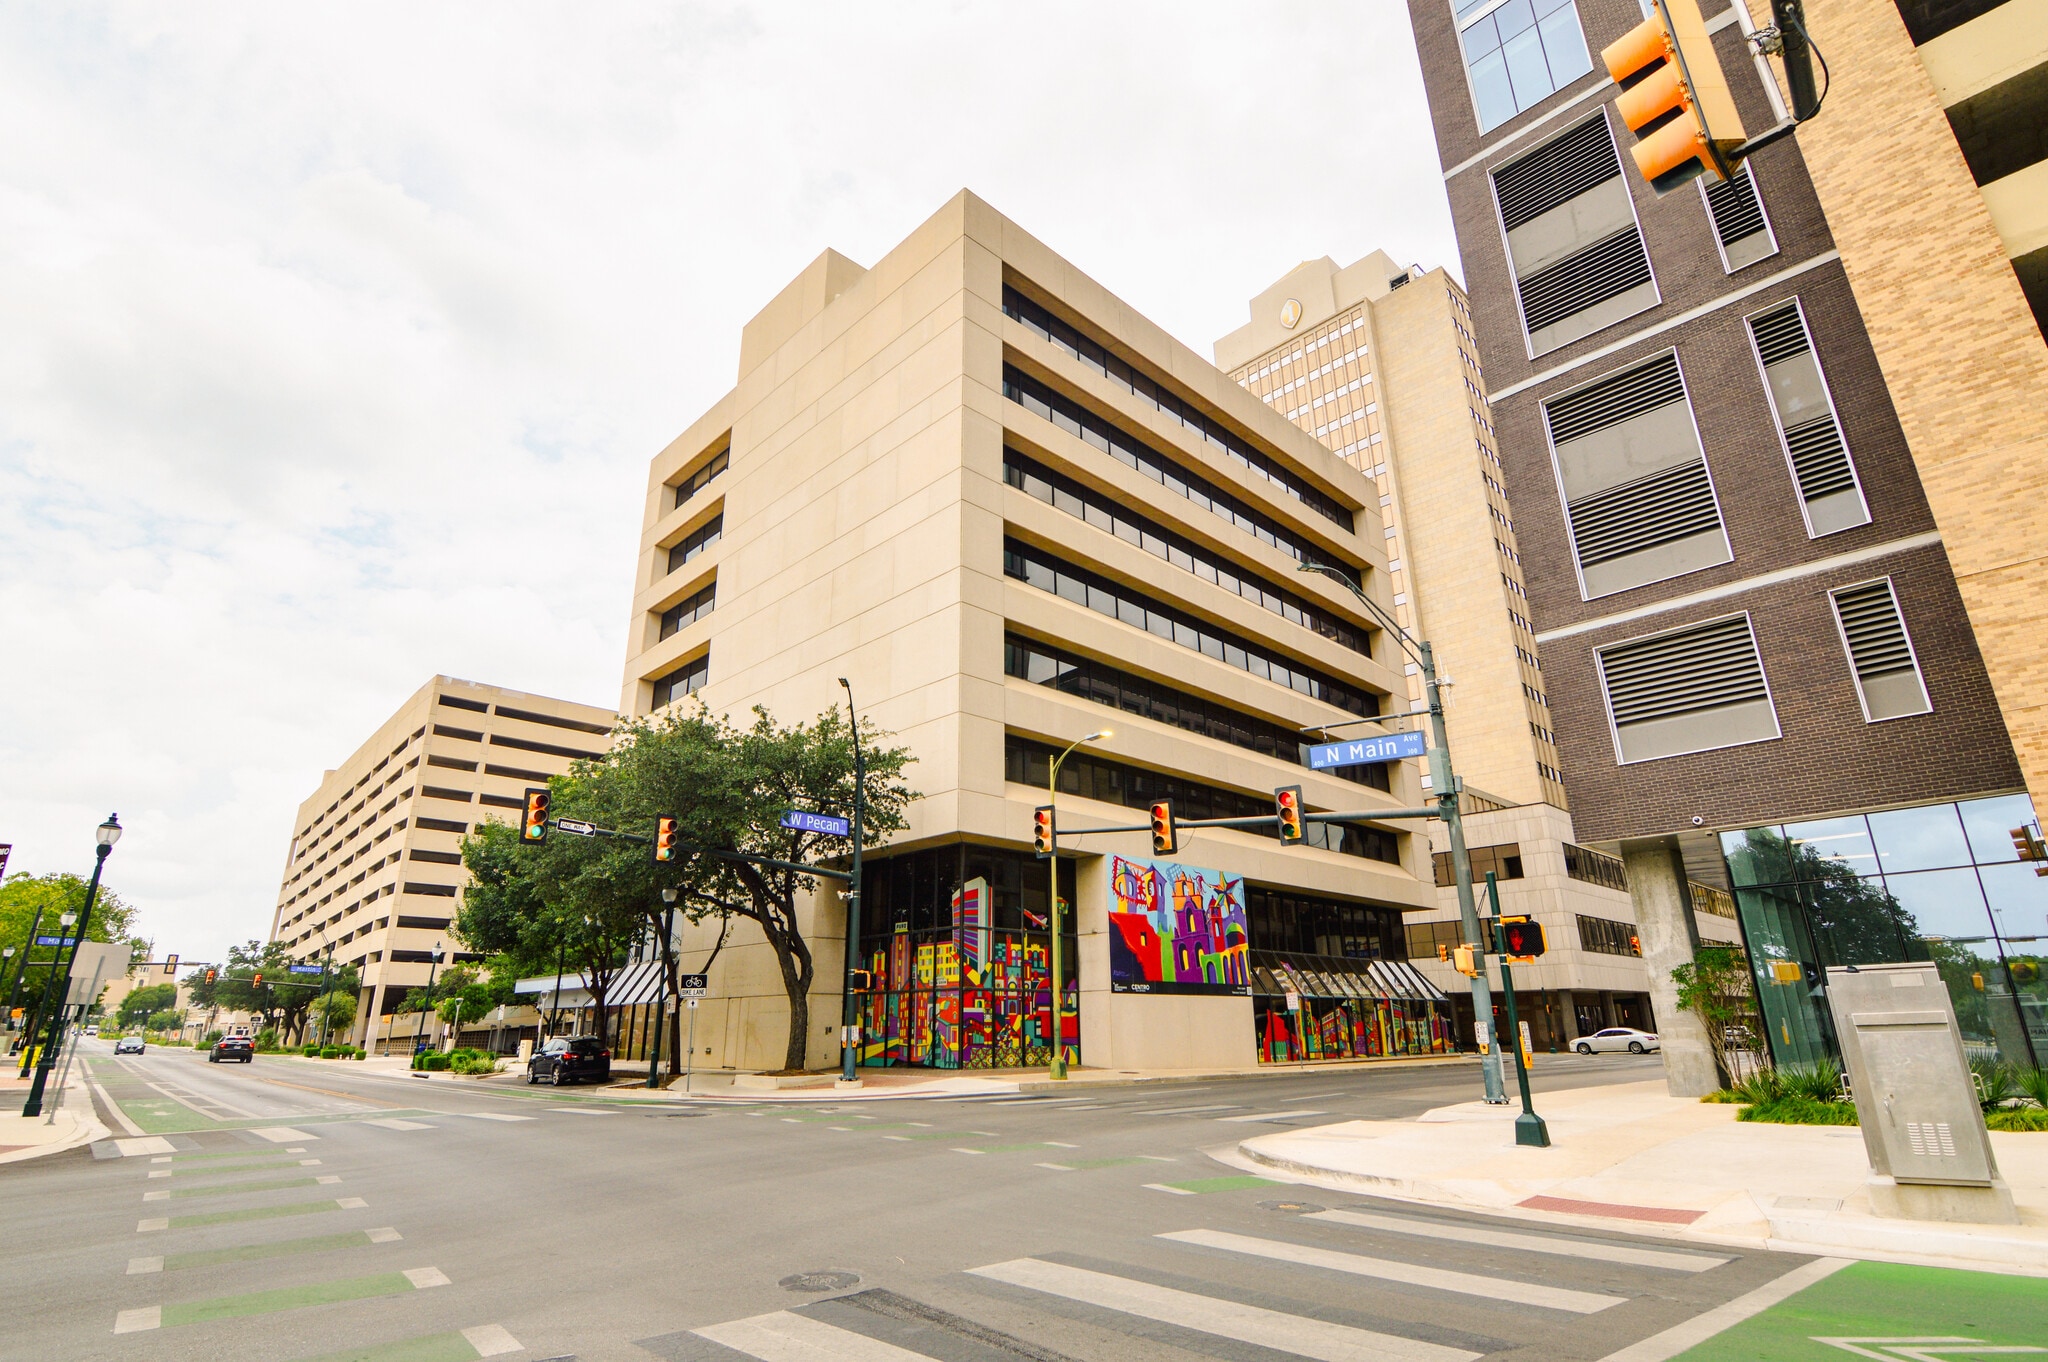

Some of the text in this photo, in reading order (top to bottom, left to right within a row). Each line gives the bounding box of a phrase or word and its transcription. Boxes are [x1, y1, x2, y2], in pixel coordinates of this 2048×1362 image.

[1326, 734, 1418, 763] N Main Ave
[790, 812, 802, 826] W
[806, 815, 839, 832] Pecan
